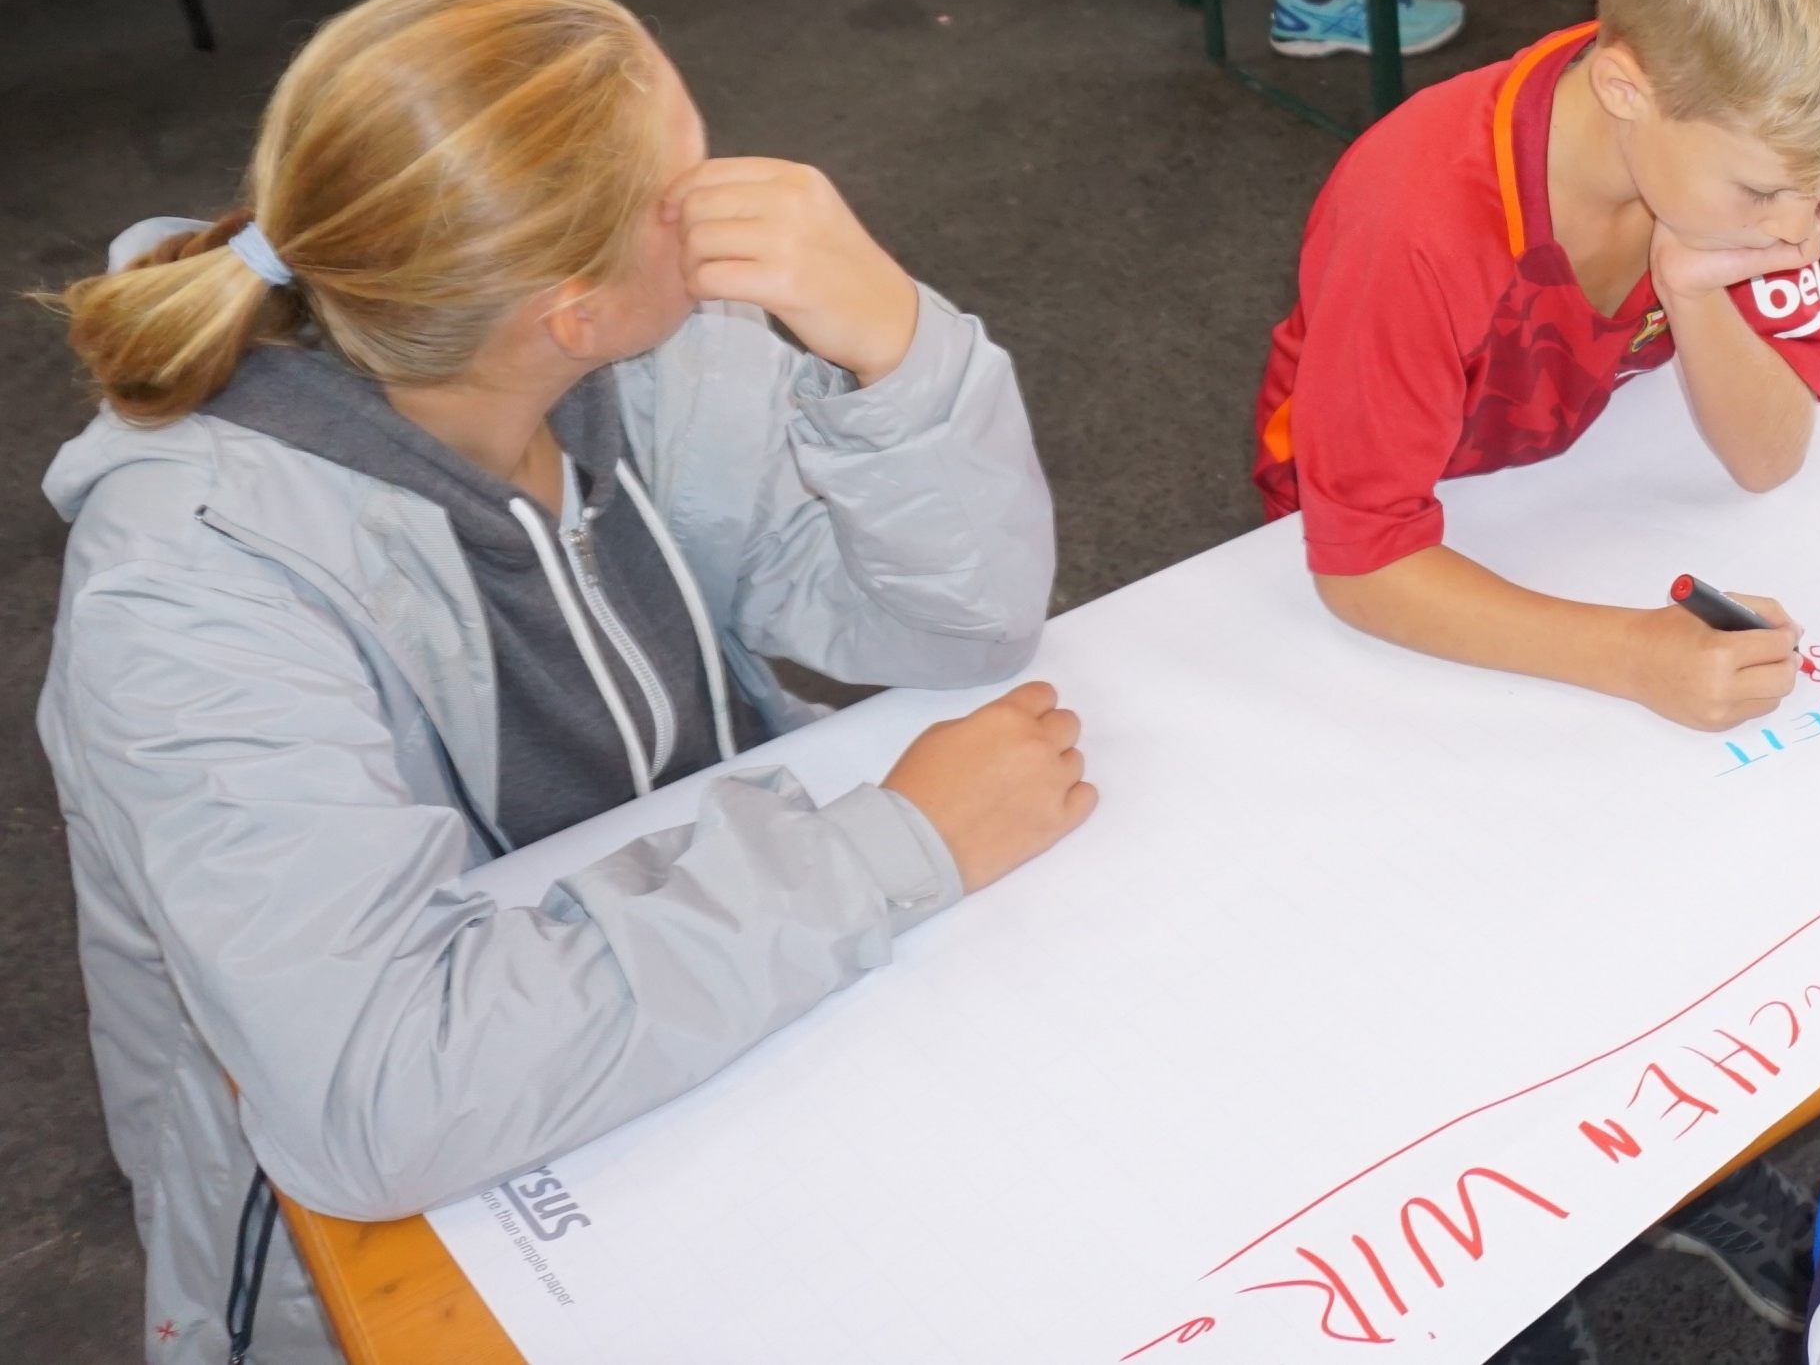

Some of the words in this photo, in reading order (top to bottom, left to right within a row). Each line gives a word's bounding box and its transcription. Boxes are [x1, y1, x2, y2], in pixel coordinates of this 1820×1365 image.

[480, 1190, 502, 1210] ore
[494, 1209, 521, 1237] than
[513, 1234, 548, 1272] simple
[538, 1272, 576, 1307] paper
[515, 1165, 592, 1242] rsus
